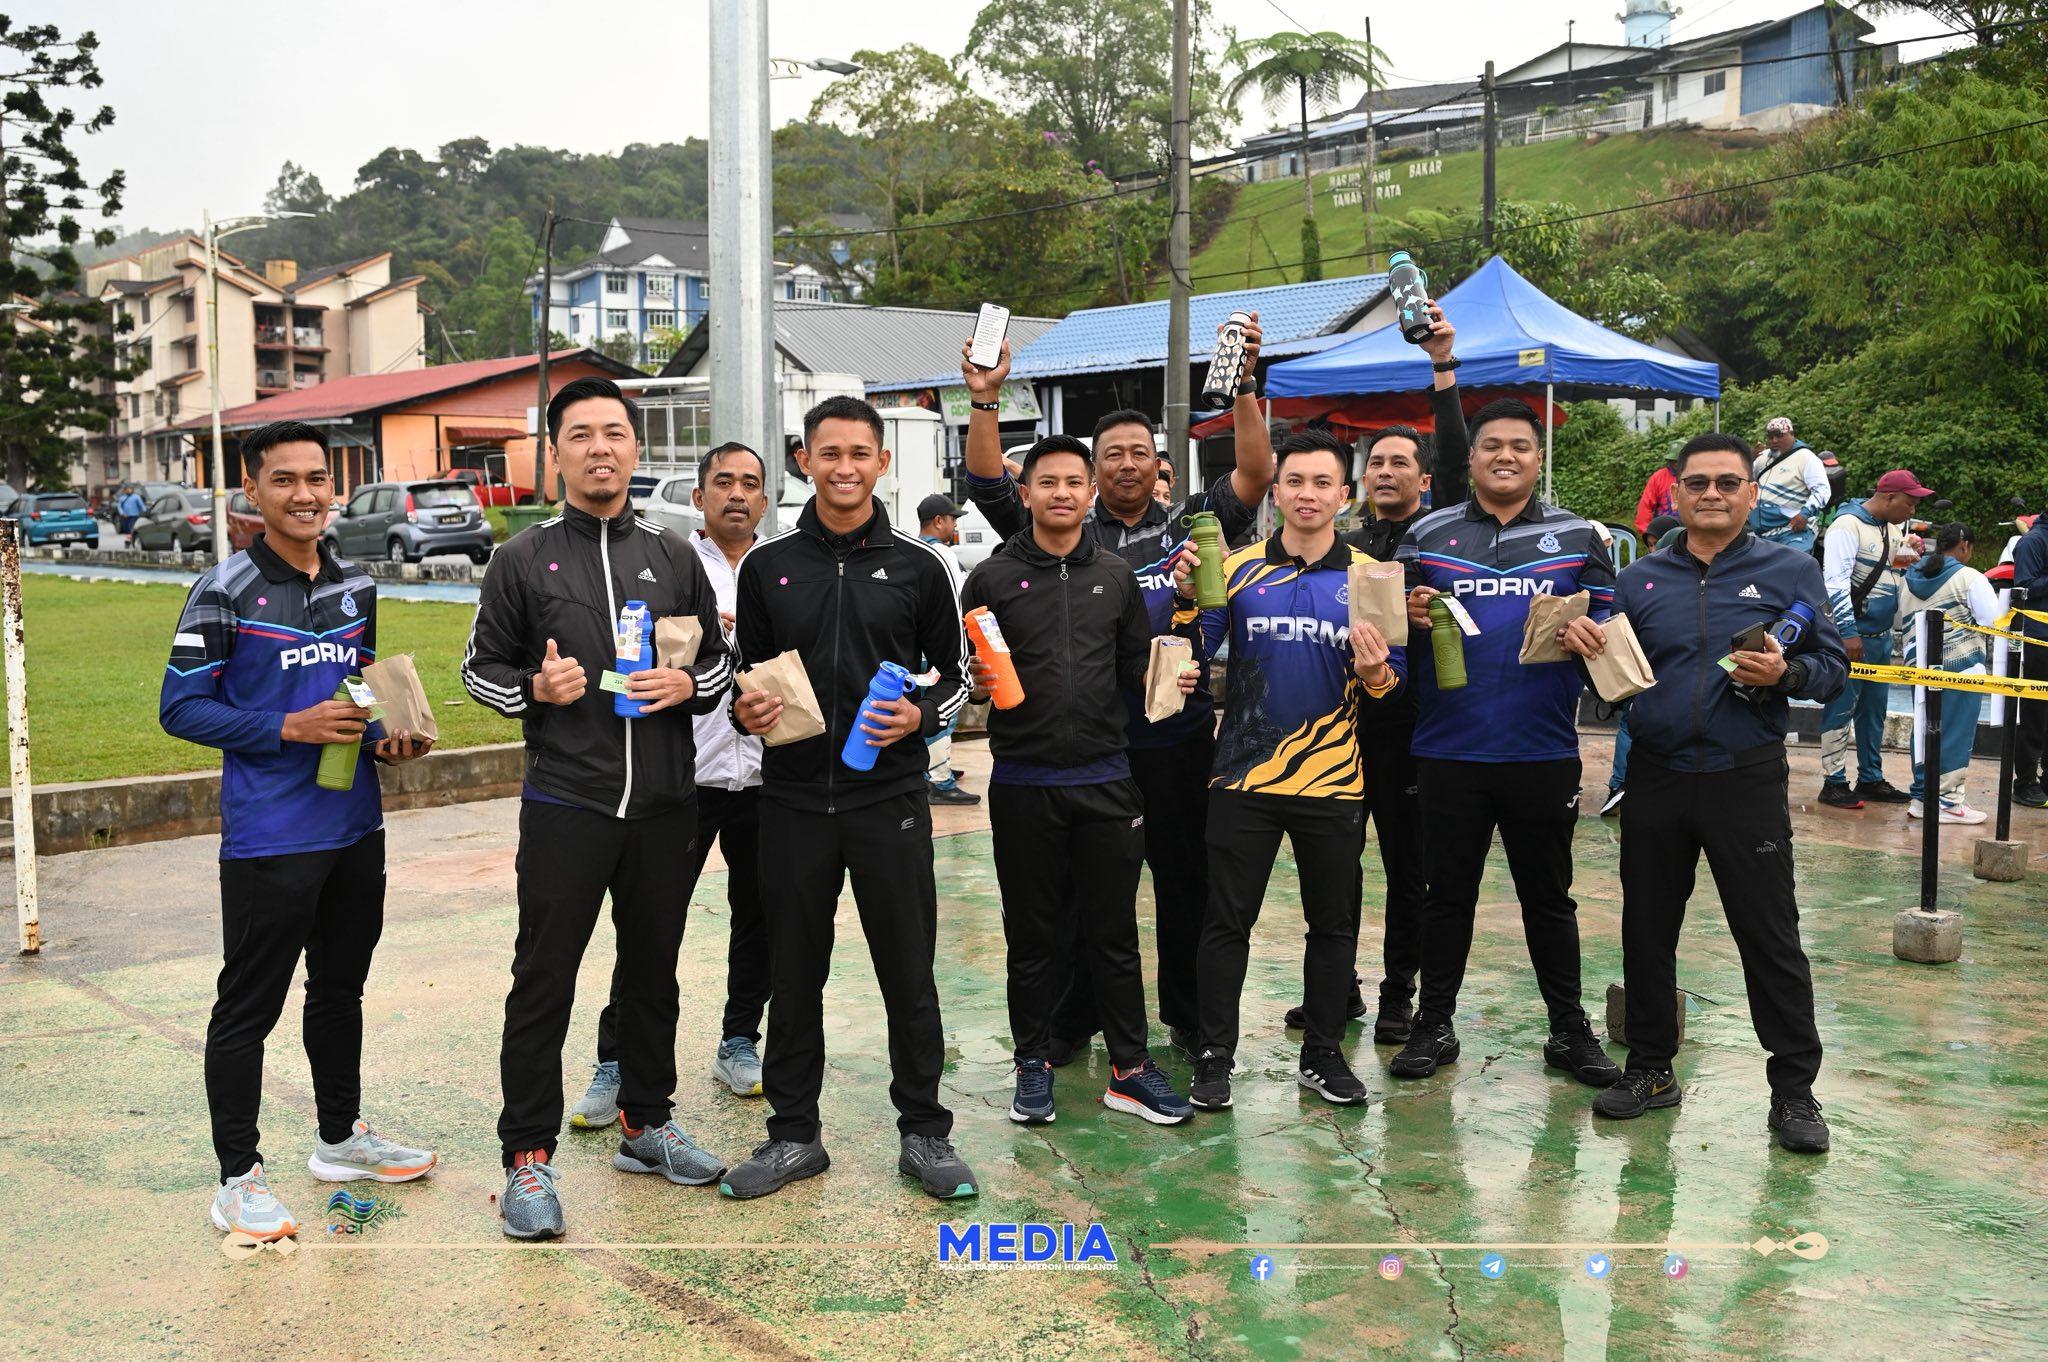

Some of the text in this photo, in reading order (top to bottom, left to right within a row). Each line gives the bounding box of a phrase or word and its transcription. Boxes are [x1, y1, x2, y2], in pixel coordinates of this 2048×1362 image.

[1409, 159, 1442, 178] BAKAR
[1376, 184, 1401, 200] RATA
[1452, 577, 1555, 597] PDRM
[1246, 616, 1350, 651] PDRM
